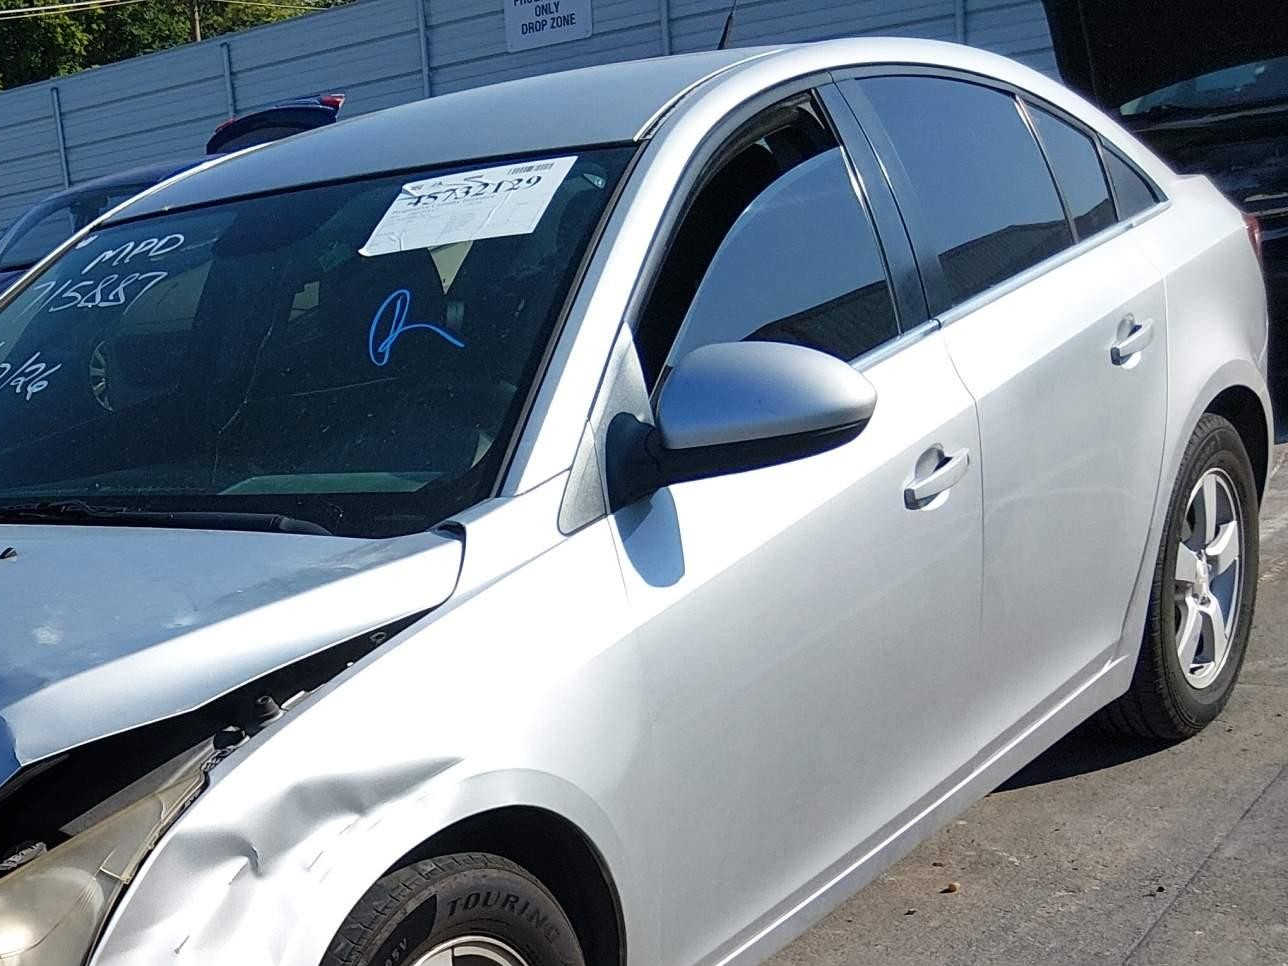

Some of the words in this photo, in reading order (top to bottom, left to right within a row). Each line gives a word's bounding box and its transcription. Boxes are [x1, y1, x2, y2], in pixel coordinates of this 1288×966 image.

[521, 18, 548, 35] DROP
[550, 13, 576, 30] ZONE
[534, 1, 560, 17] ONLY
[407, 175, 543, 208] 45732129
[81, 234, 185, 274] MPD
[17, 272, 169, 316] 715887
[448, 890, 561, 945] TOURING
